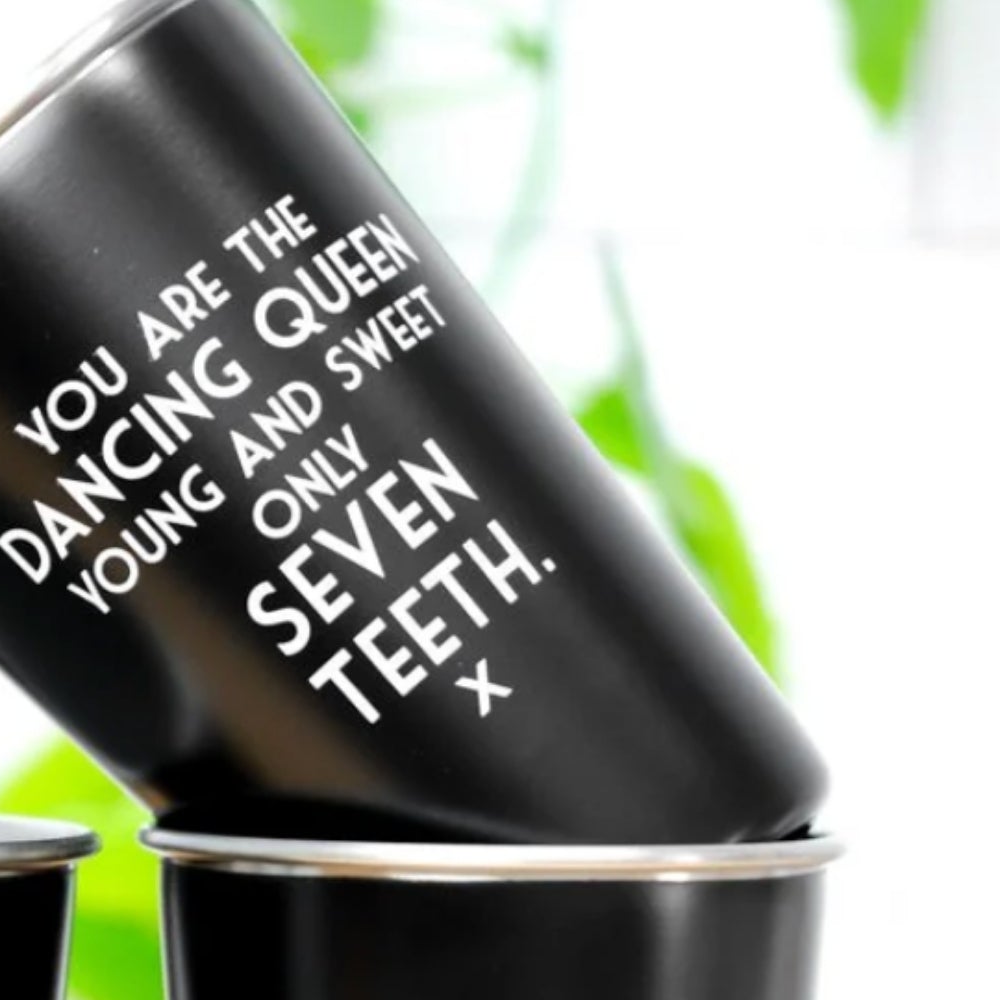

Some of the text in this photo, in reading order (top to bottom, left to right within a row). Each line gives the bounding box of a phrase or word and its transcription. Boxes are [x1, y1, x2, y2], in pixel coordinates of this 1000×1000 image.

[15, 195, 316, 454] YOU ARE THE
[254, 214, 420, 348] QUEEN
[68, 284, 446, 613] YOUNG AND SWEET
[248, 438, 478, 655] SEVEN
[253, 424, 368, 538] ONLY
[309, 519, 556, 723] TEETH.
